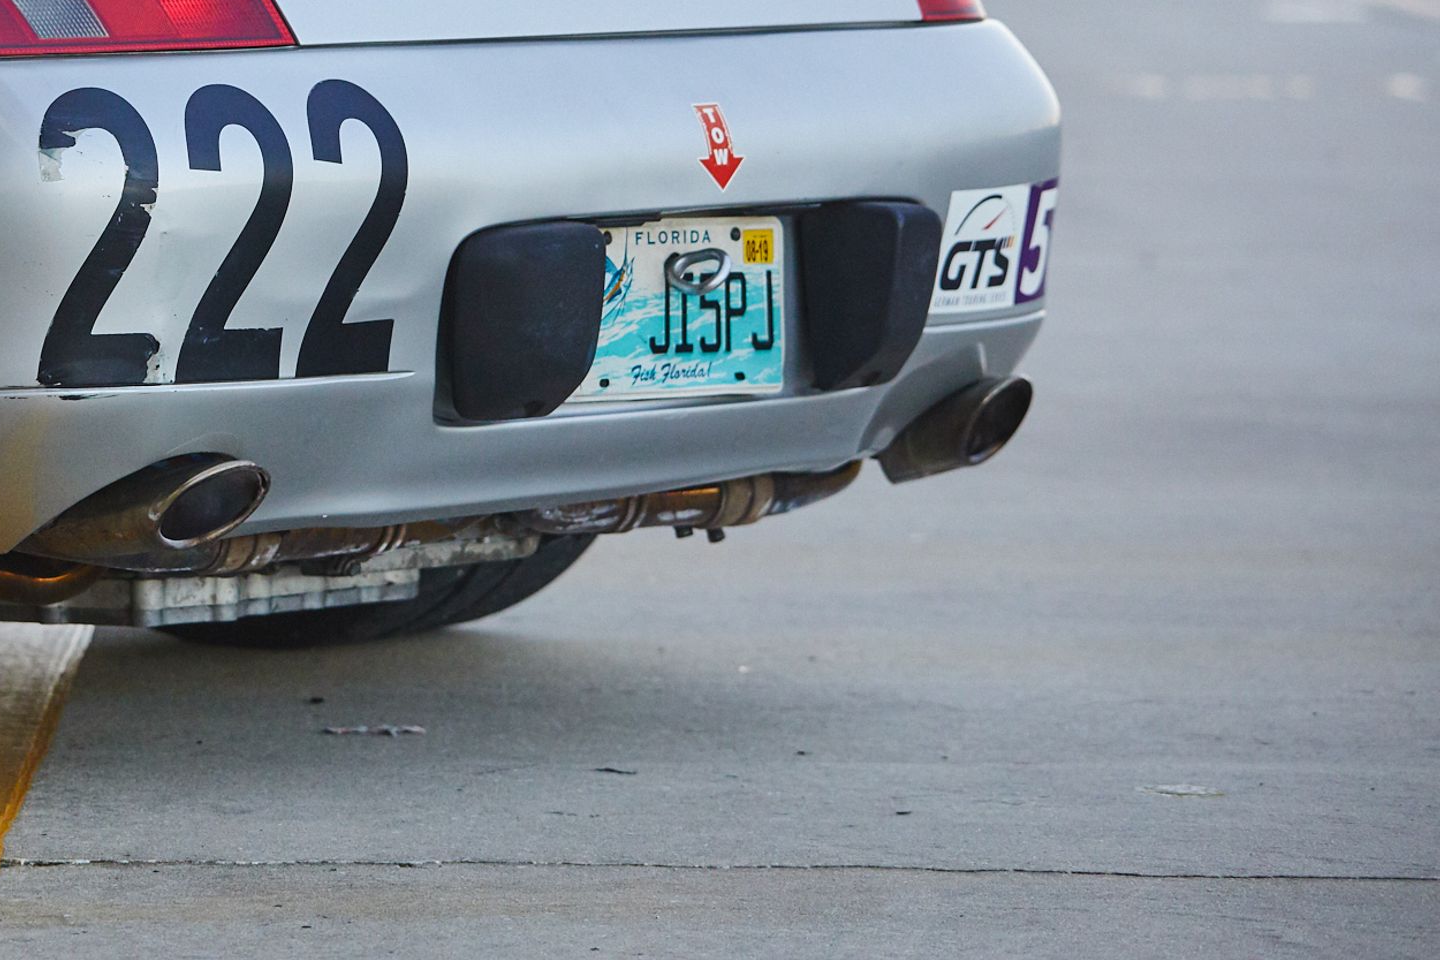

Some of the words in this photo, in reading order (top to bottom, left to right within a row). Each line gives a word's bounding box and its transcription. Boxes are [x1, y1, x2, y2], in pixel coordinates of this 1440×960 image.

[702, 107, 729, 166] TOW
[36, 78, 409, 387] 222
[635, 229, 711, 246] FLORIDA
[940, 237, 1011, 291] GTS
[630, 364, 657, 386] Fish
[661, 361, 713, 384] Florida!
